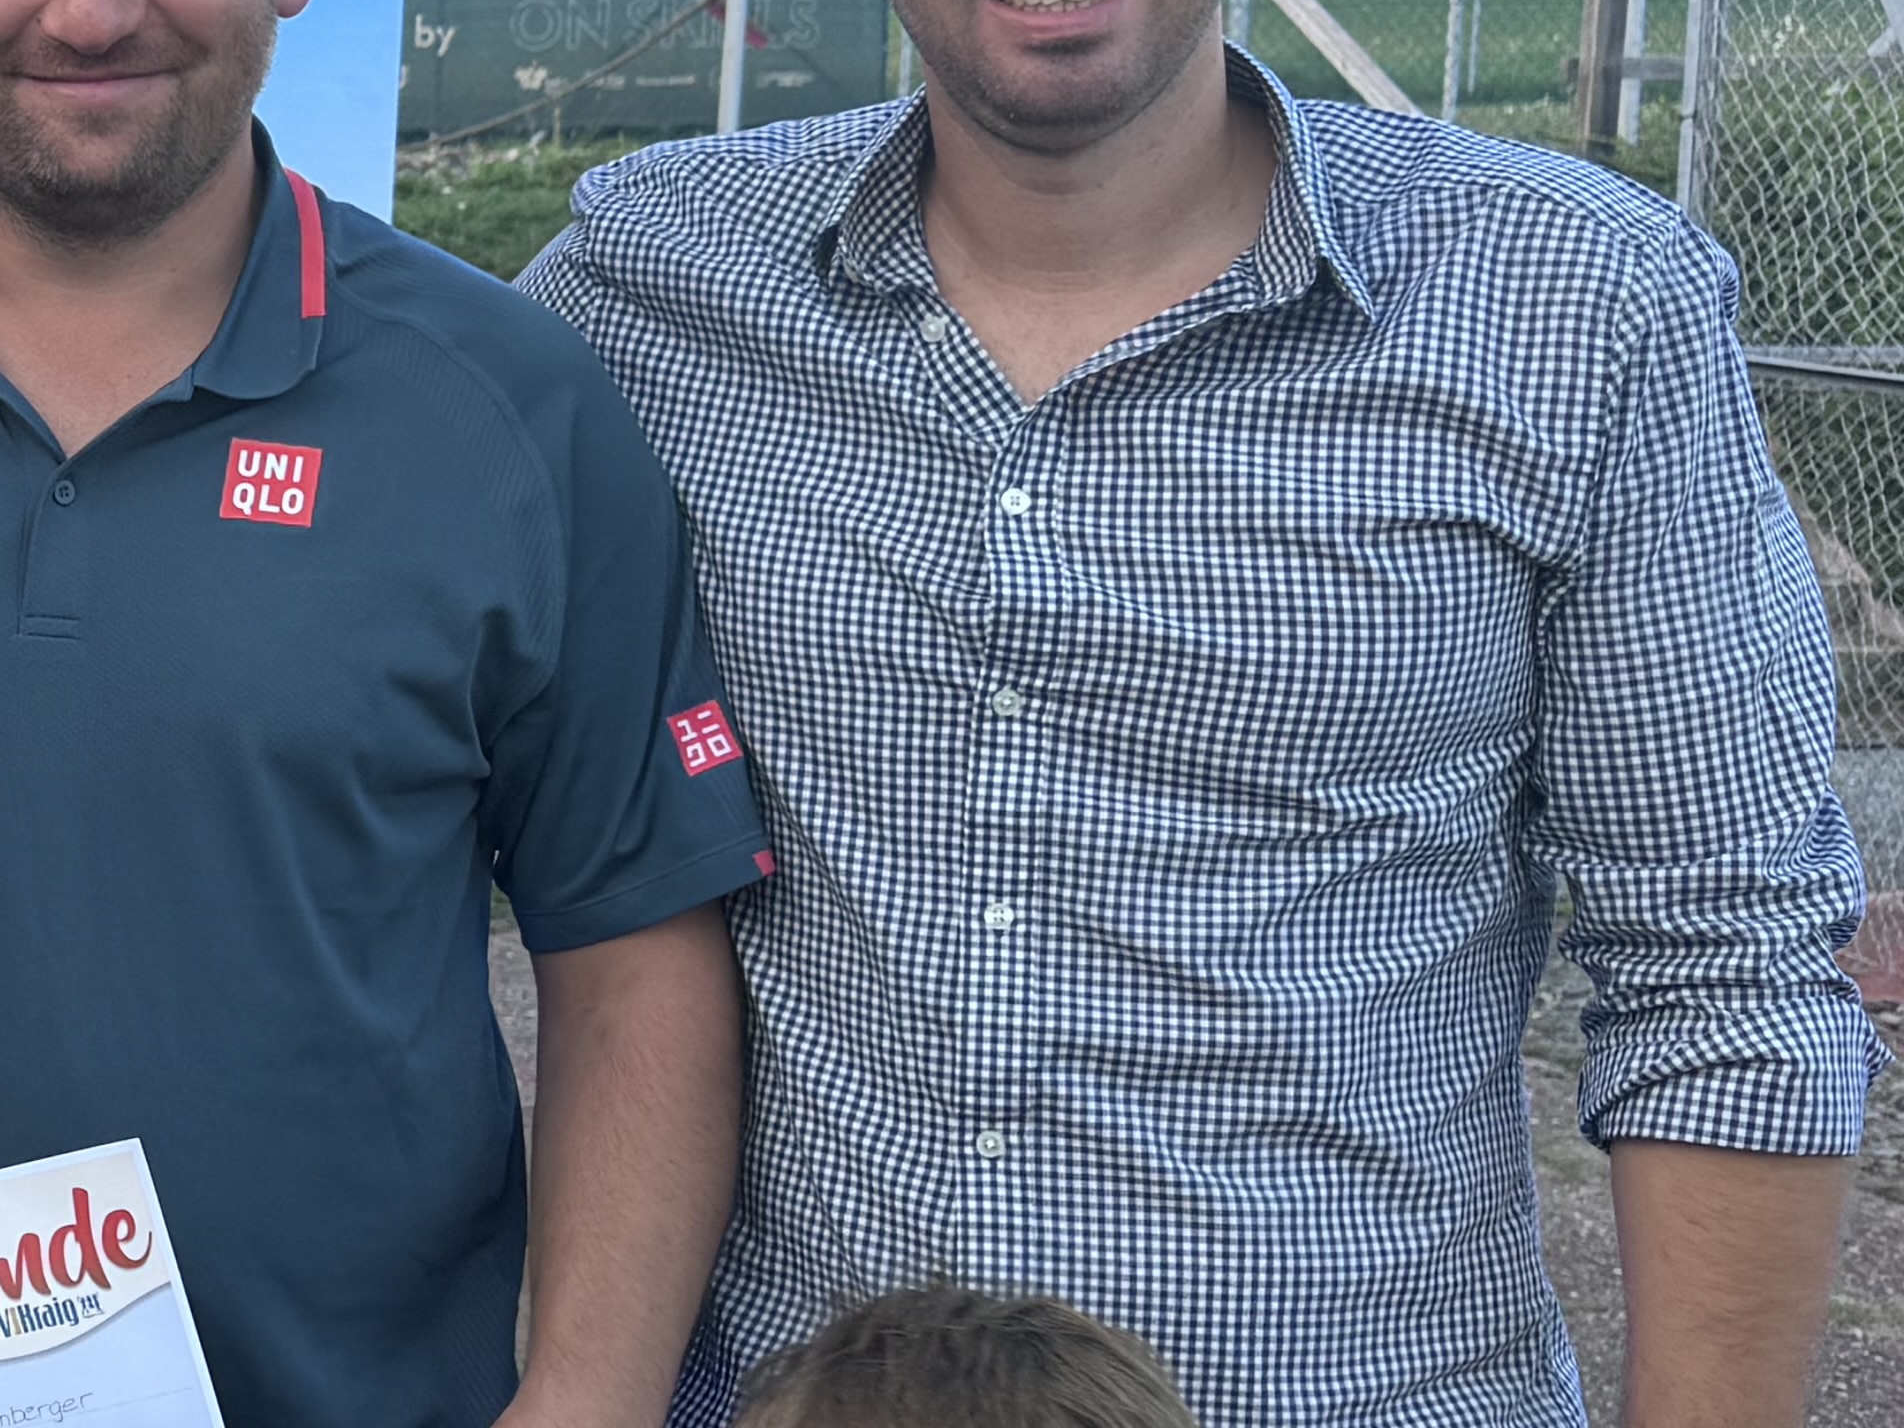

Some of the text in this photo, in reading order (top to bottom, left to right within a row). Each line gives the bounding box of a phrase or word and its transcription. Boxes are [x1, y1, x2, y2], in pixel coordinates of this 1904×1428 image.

[414, 14, 457, 58] by
[237, 449, 304, 483] UNI
[232, 482, 305, 516] QLO
